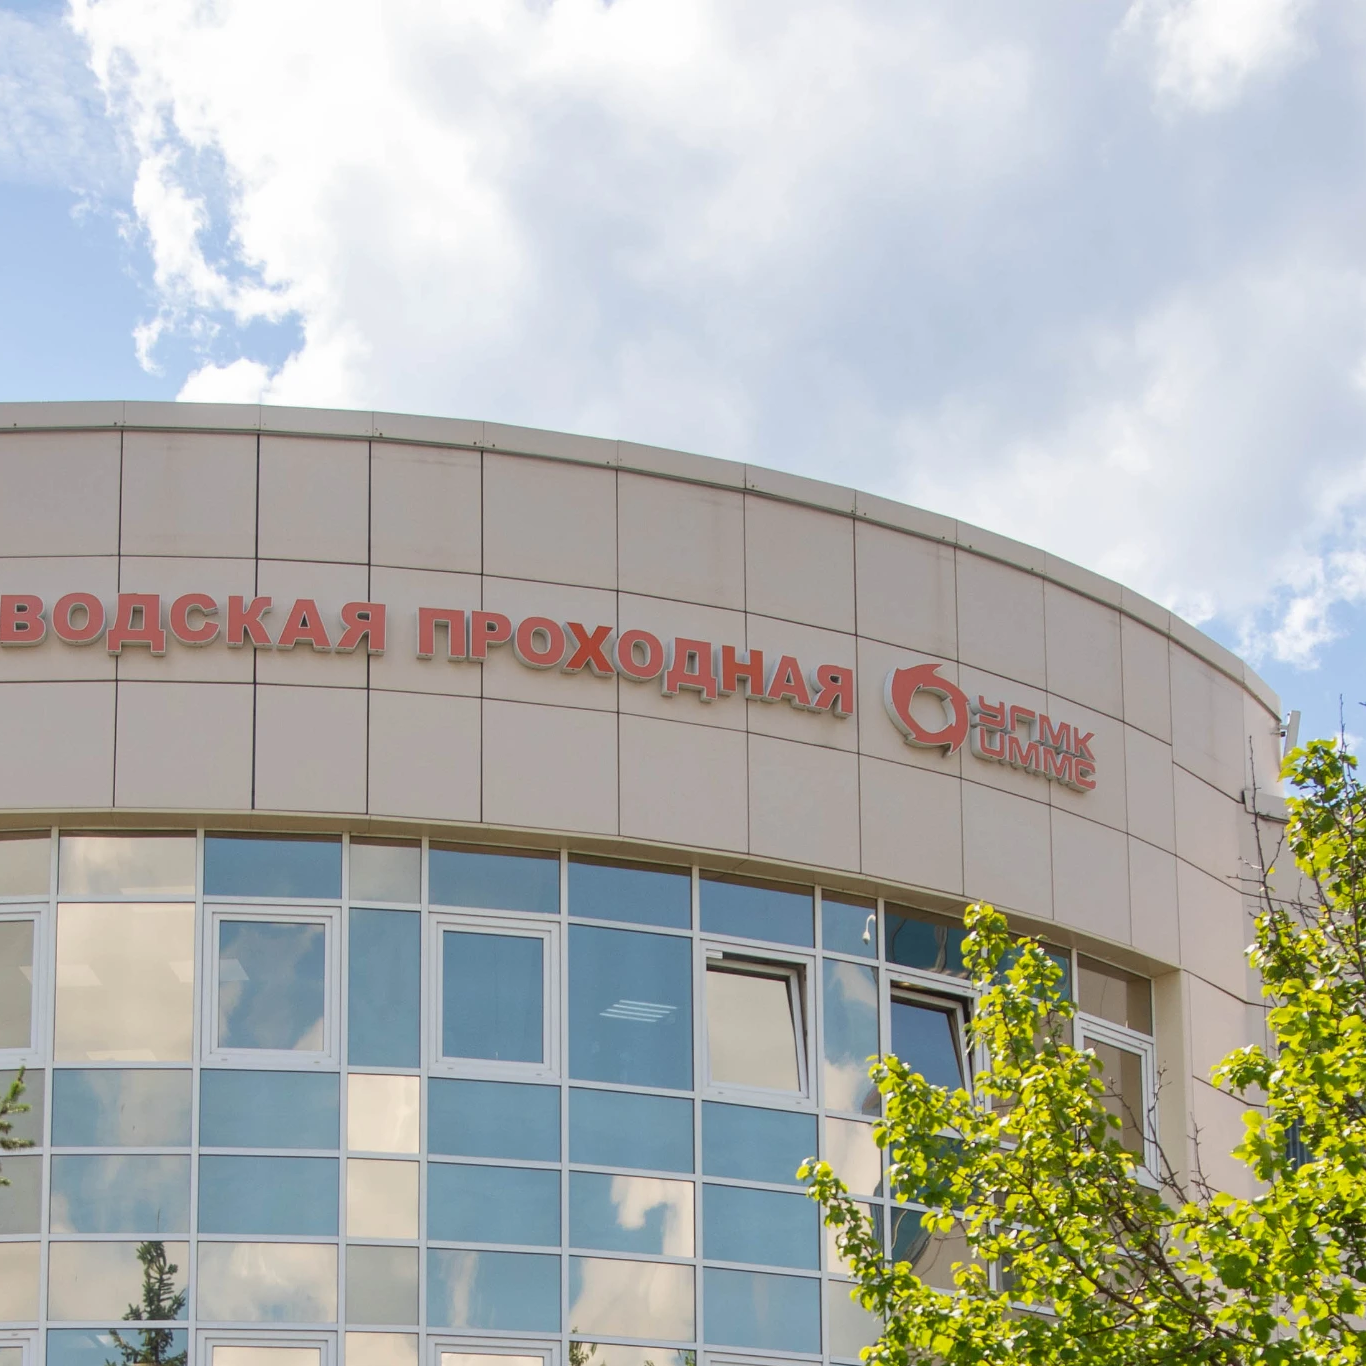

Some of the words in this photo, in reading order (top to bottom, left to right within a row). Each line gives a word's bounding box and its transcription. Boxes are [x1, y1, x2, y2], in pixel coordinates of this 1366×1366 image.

[416, 605, 854, 718] ПРОХОДНАЯ
[972, 694, 1096, 762] УГМК
[973, 726, 1097, 792] UMMC
